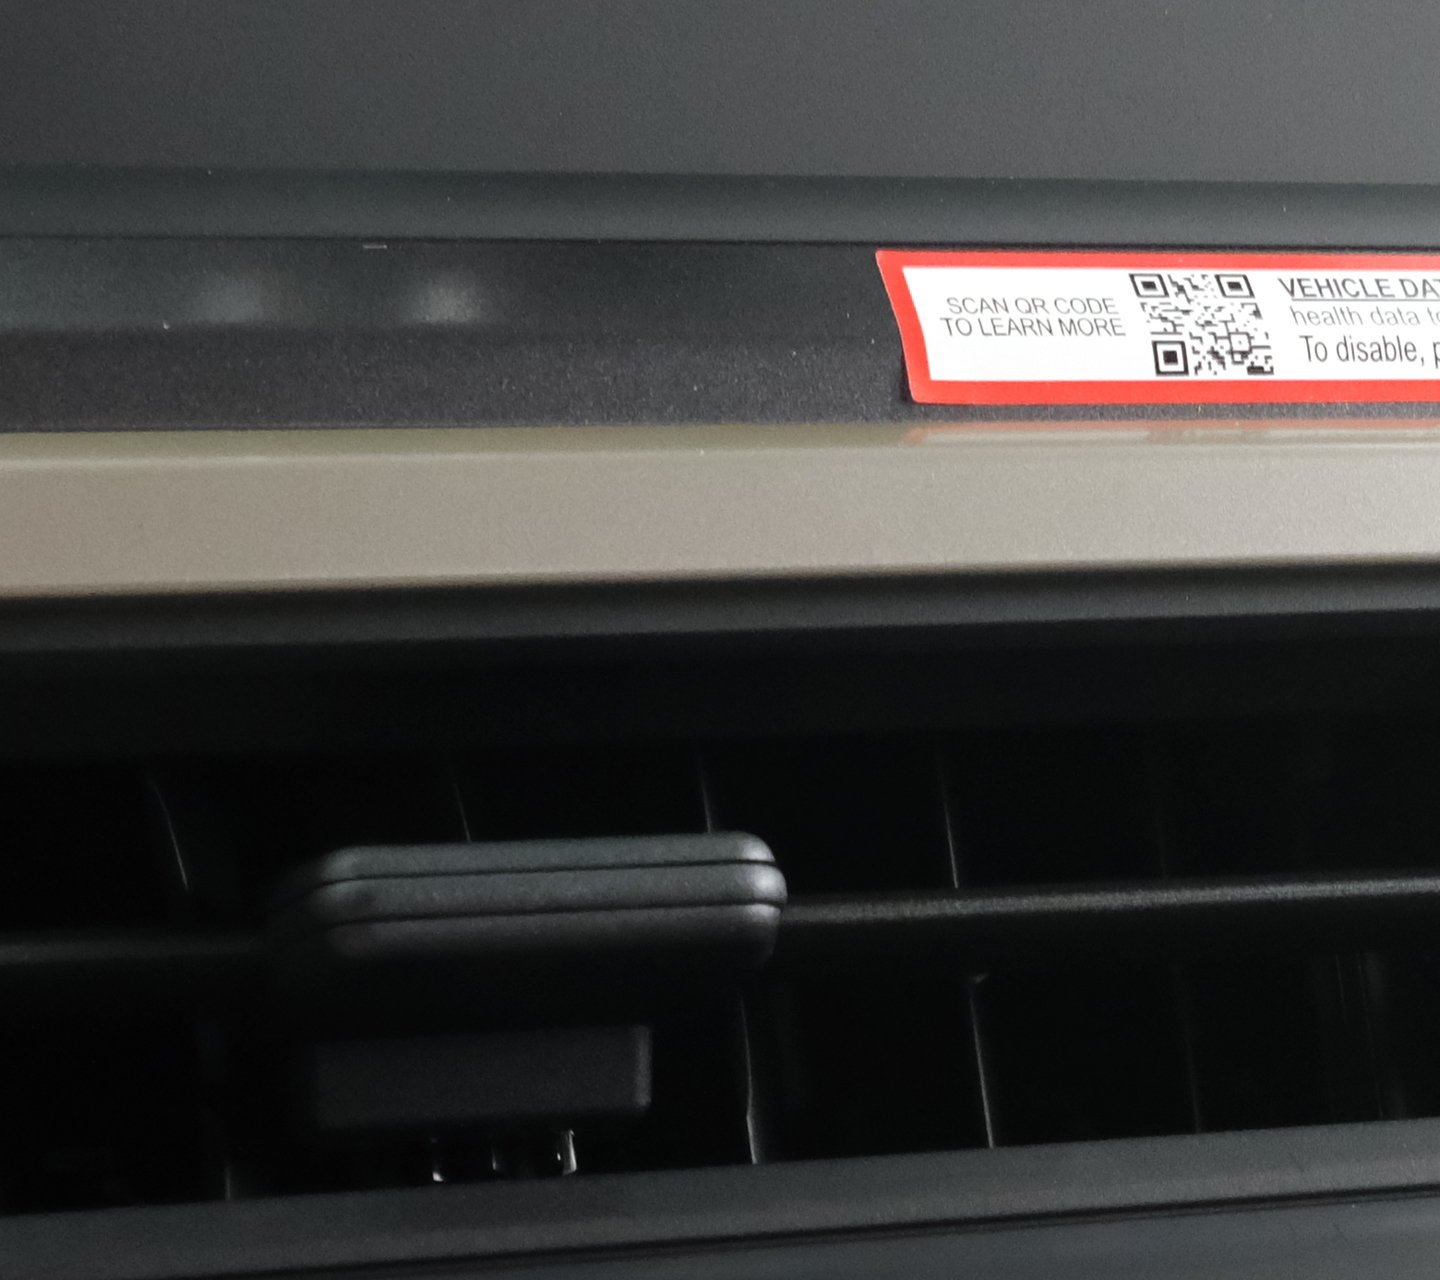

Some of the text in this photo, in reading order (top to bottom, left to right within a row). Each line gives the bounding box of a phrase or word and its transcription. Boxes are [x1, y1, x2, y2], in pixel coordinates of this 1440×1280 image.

[1278, 277, 1395, 298] VEHICLE
[946, 297, 1120, 315] SCAN QR CODE
[1289, 305, 1364, 326] health
[1370, 306, 1421, 326] data
[939, 317, 1126, 337] TO LEARN MORE
[1299, 335, 1329, 362] To
[1335, 335, 1426, 368] disable,
